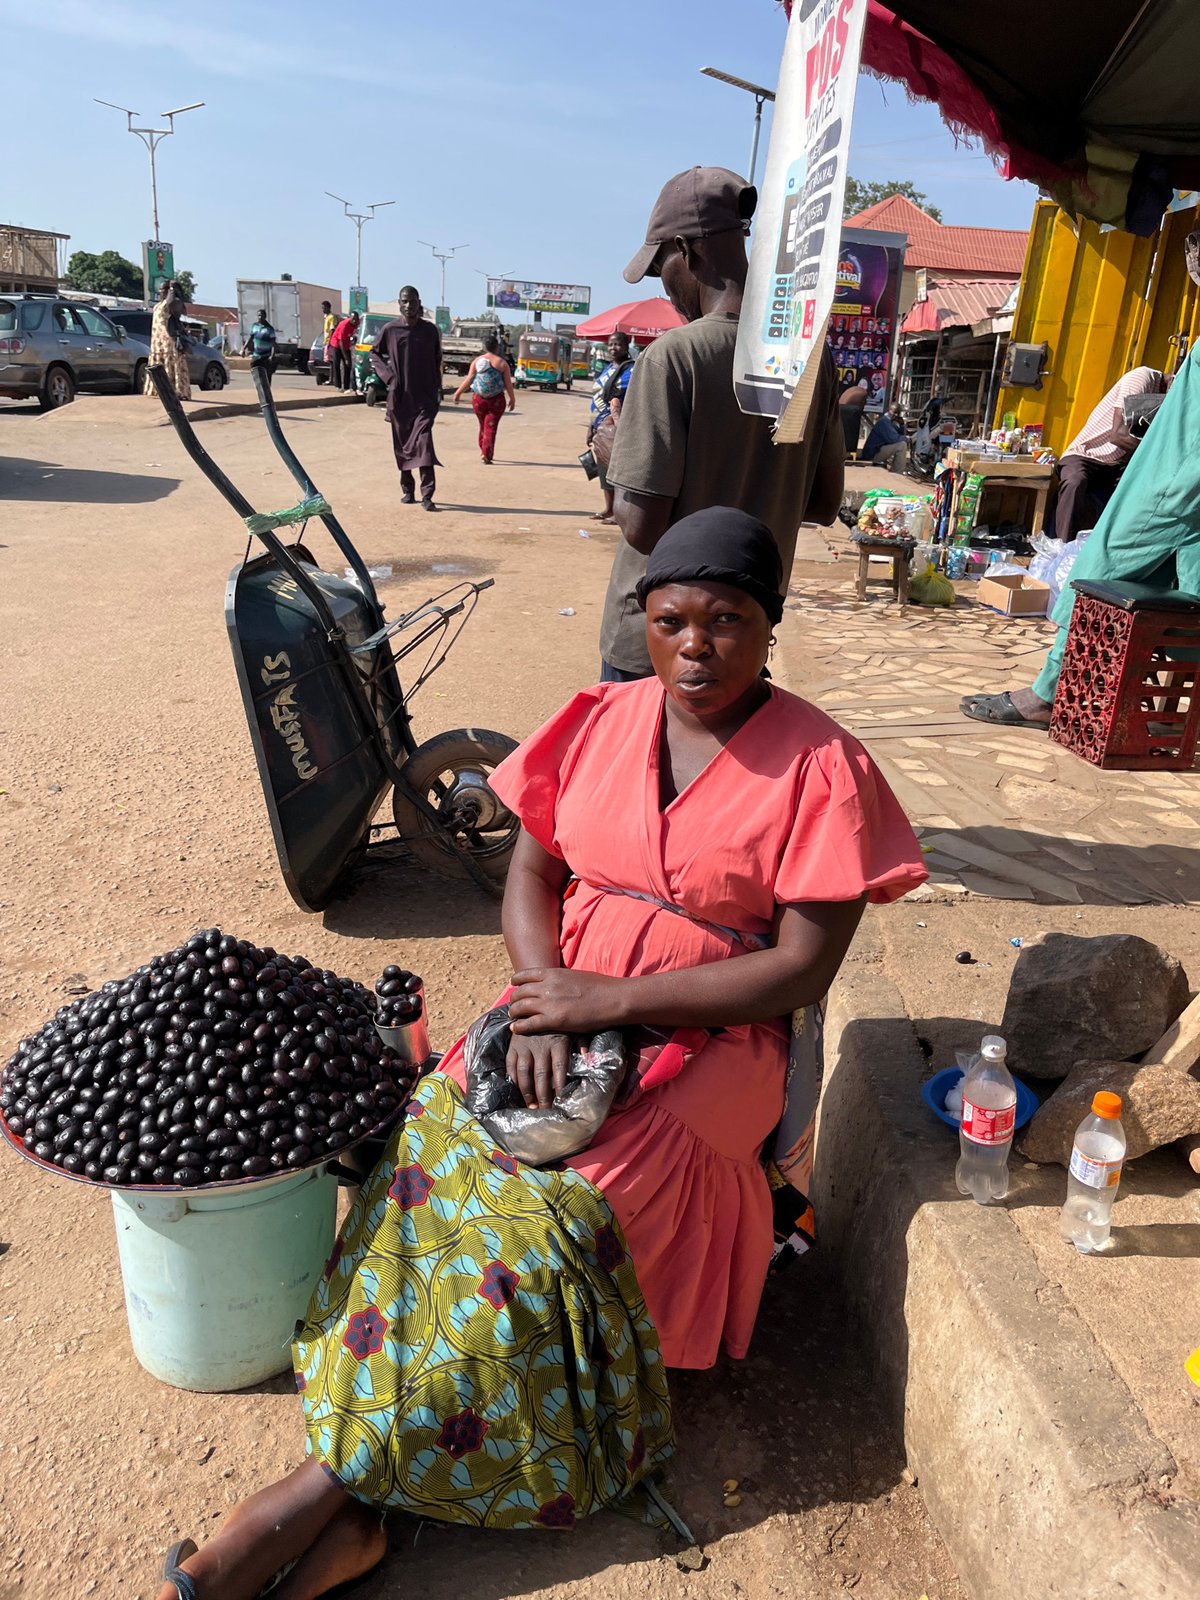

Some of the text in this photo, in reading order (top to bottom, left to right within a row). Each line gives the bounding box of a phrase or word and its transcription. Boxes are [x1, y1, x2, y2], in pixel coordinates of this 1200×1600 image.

[805, 0, 854, 119] POS
[147, 239, 173, 253] OPay
[836, 269, 862, 283] tival
